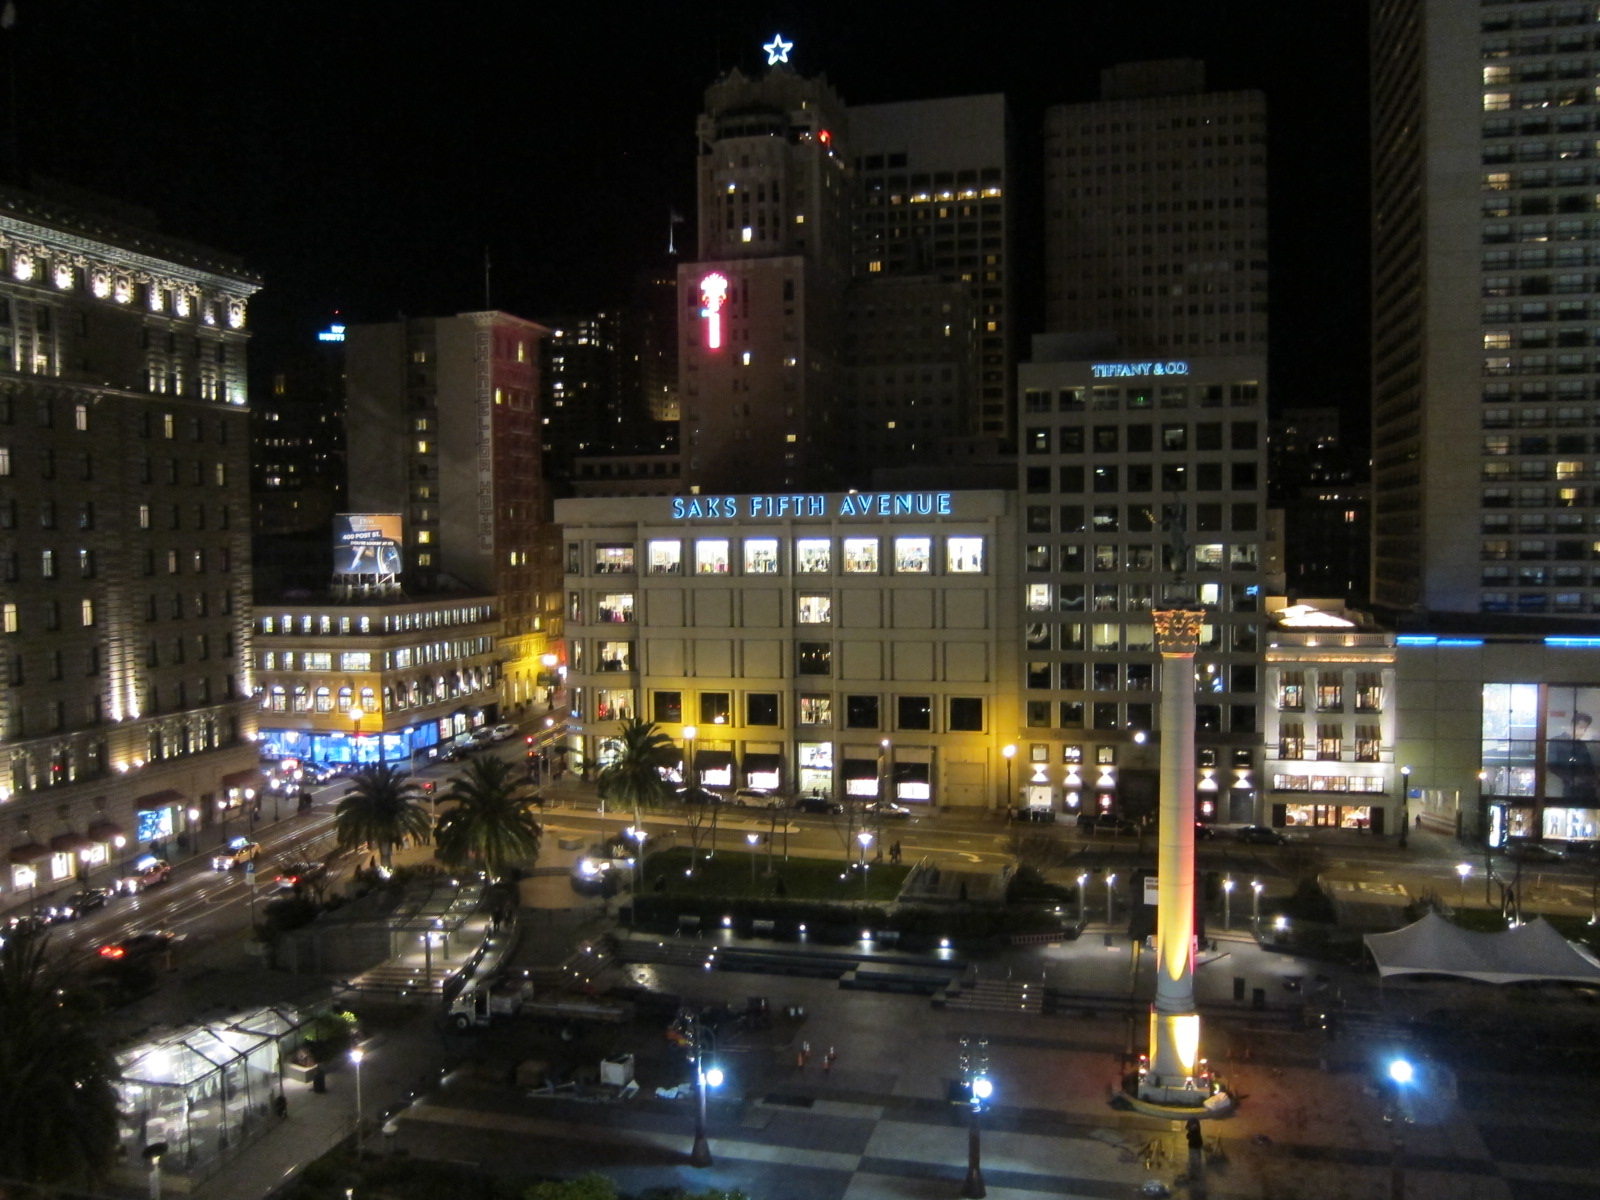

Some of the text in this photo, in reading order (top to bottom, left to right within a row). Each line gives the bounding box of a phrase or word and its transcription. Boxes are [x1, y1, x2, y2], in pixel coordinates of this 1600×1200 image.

[1091, 362, 1152, 377] TIFFANY
[1153, 362, 1165, 376] &
[477, 332, 493, 550] CHANCELLOR HOTEL
[672, 493, 952, 519] SAKS FIFTH AVENUE
